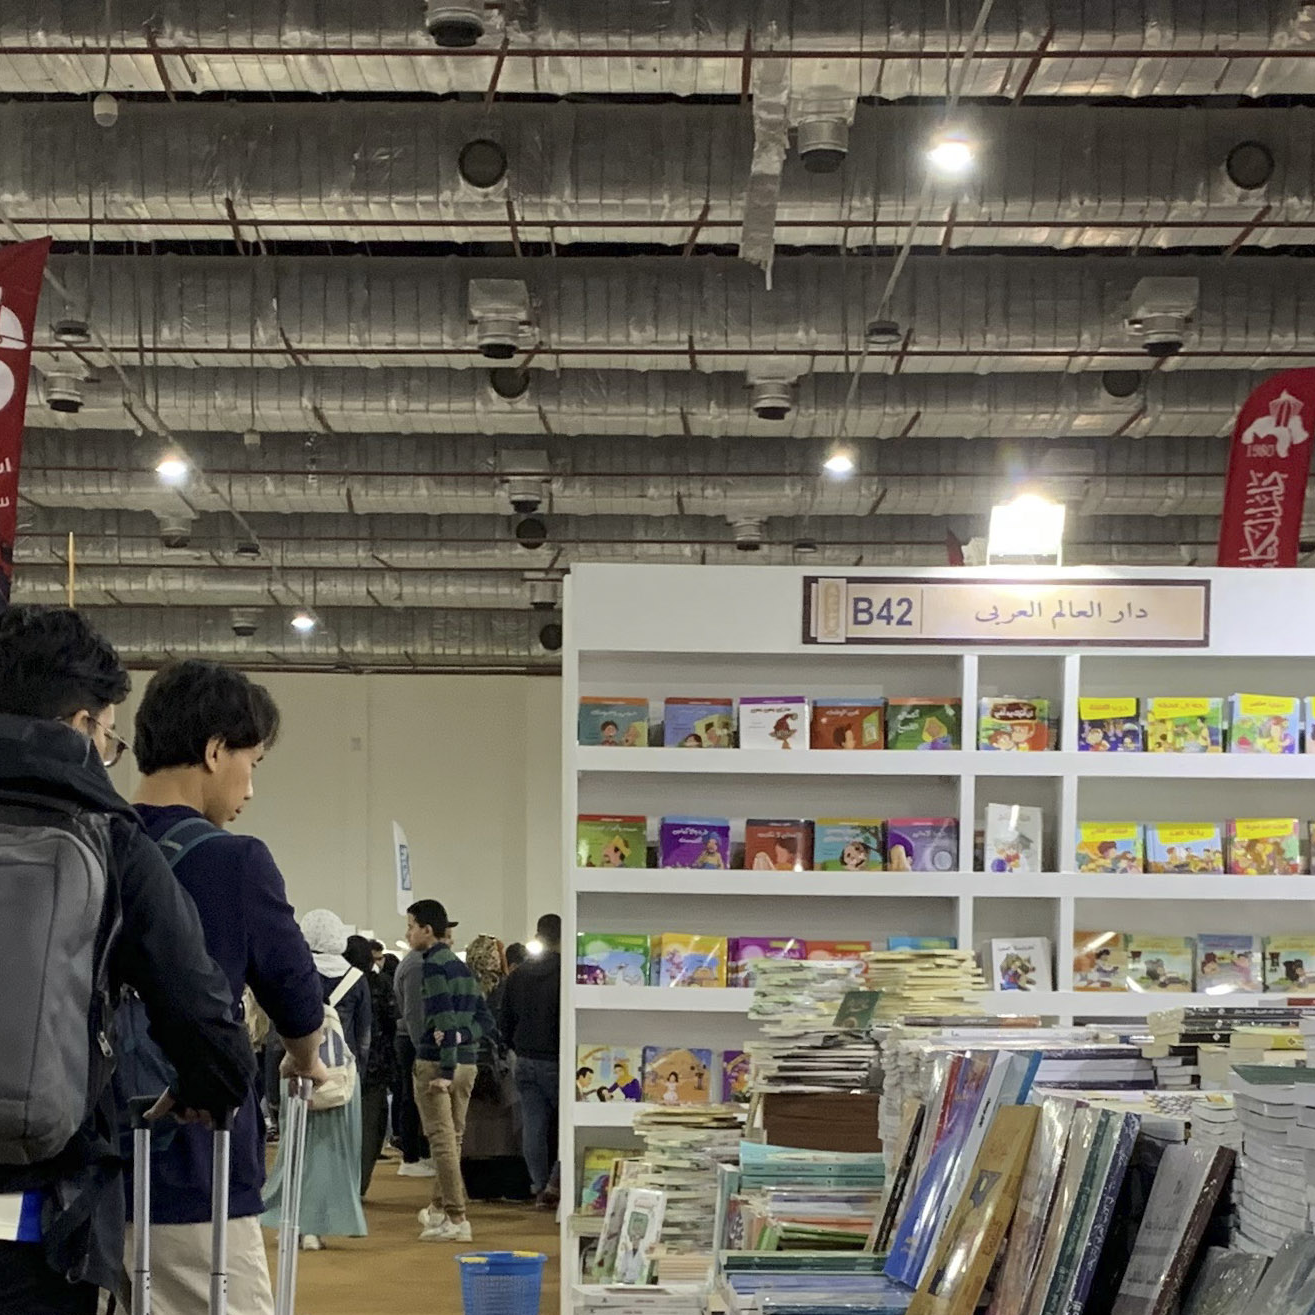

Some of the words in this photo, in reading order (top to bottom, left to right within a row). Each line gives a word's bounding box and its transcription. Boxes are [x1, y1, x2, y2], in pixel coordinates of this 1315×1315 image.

[852, 597, 913, 626] B42
[1051, 599, 1102, 629] العالم
[1110, 602, 1148, 624] دار
